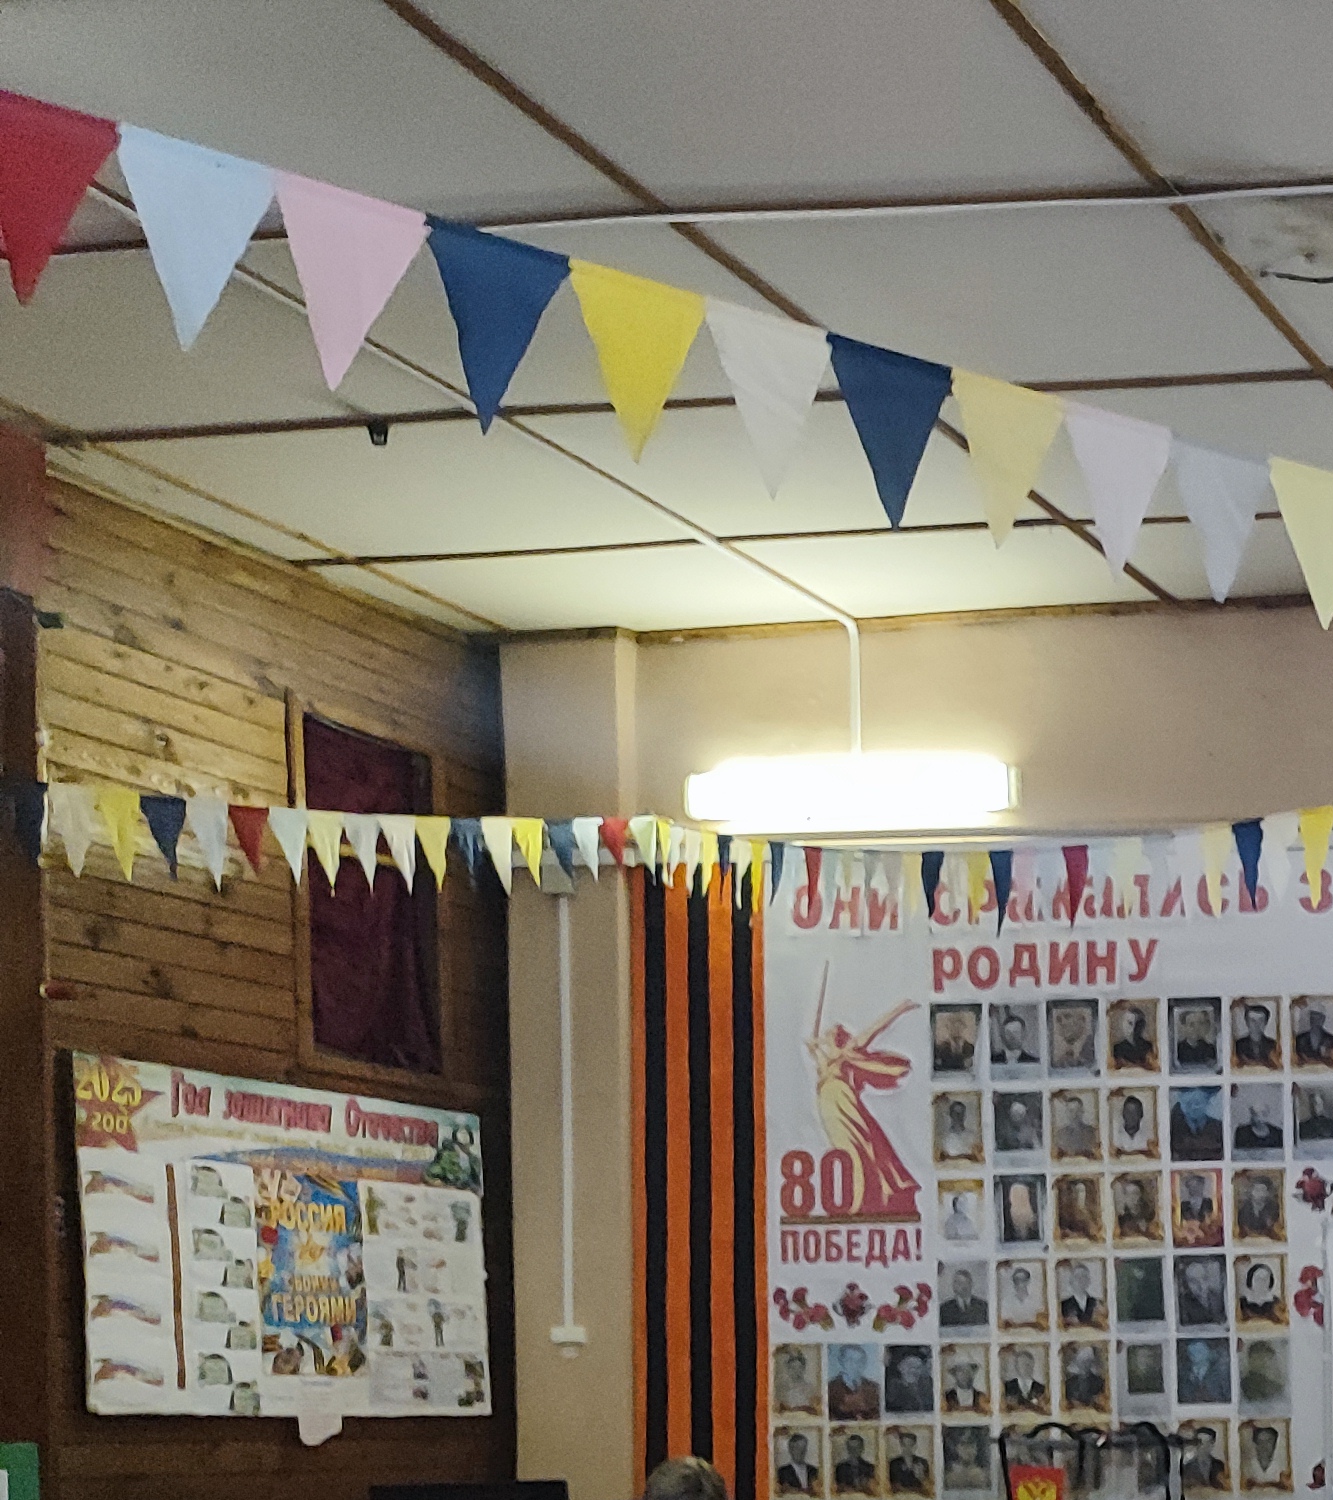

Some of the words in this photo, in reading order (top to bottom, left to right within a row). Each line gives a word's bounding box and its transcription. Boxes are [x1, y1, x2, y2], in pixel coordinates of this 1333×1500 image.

[780, 1150, 854, 1216] 80
[780, 1228, 922, 1268] ПОБЕДА!
[272, 1293, 357, 1325] ГЕРОЯМИ
